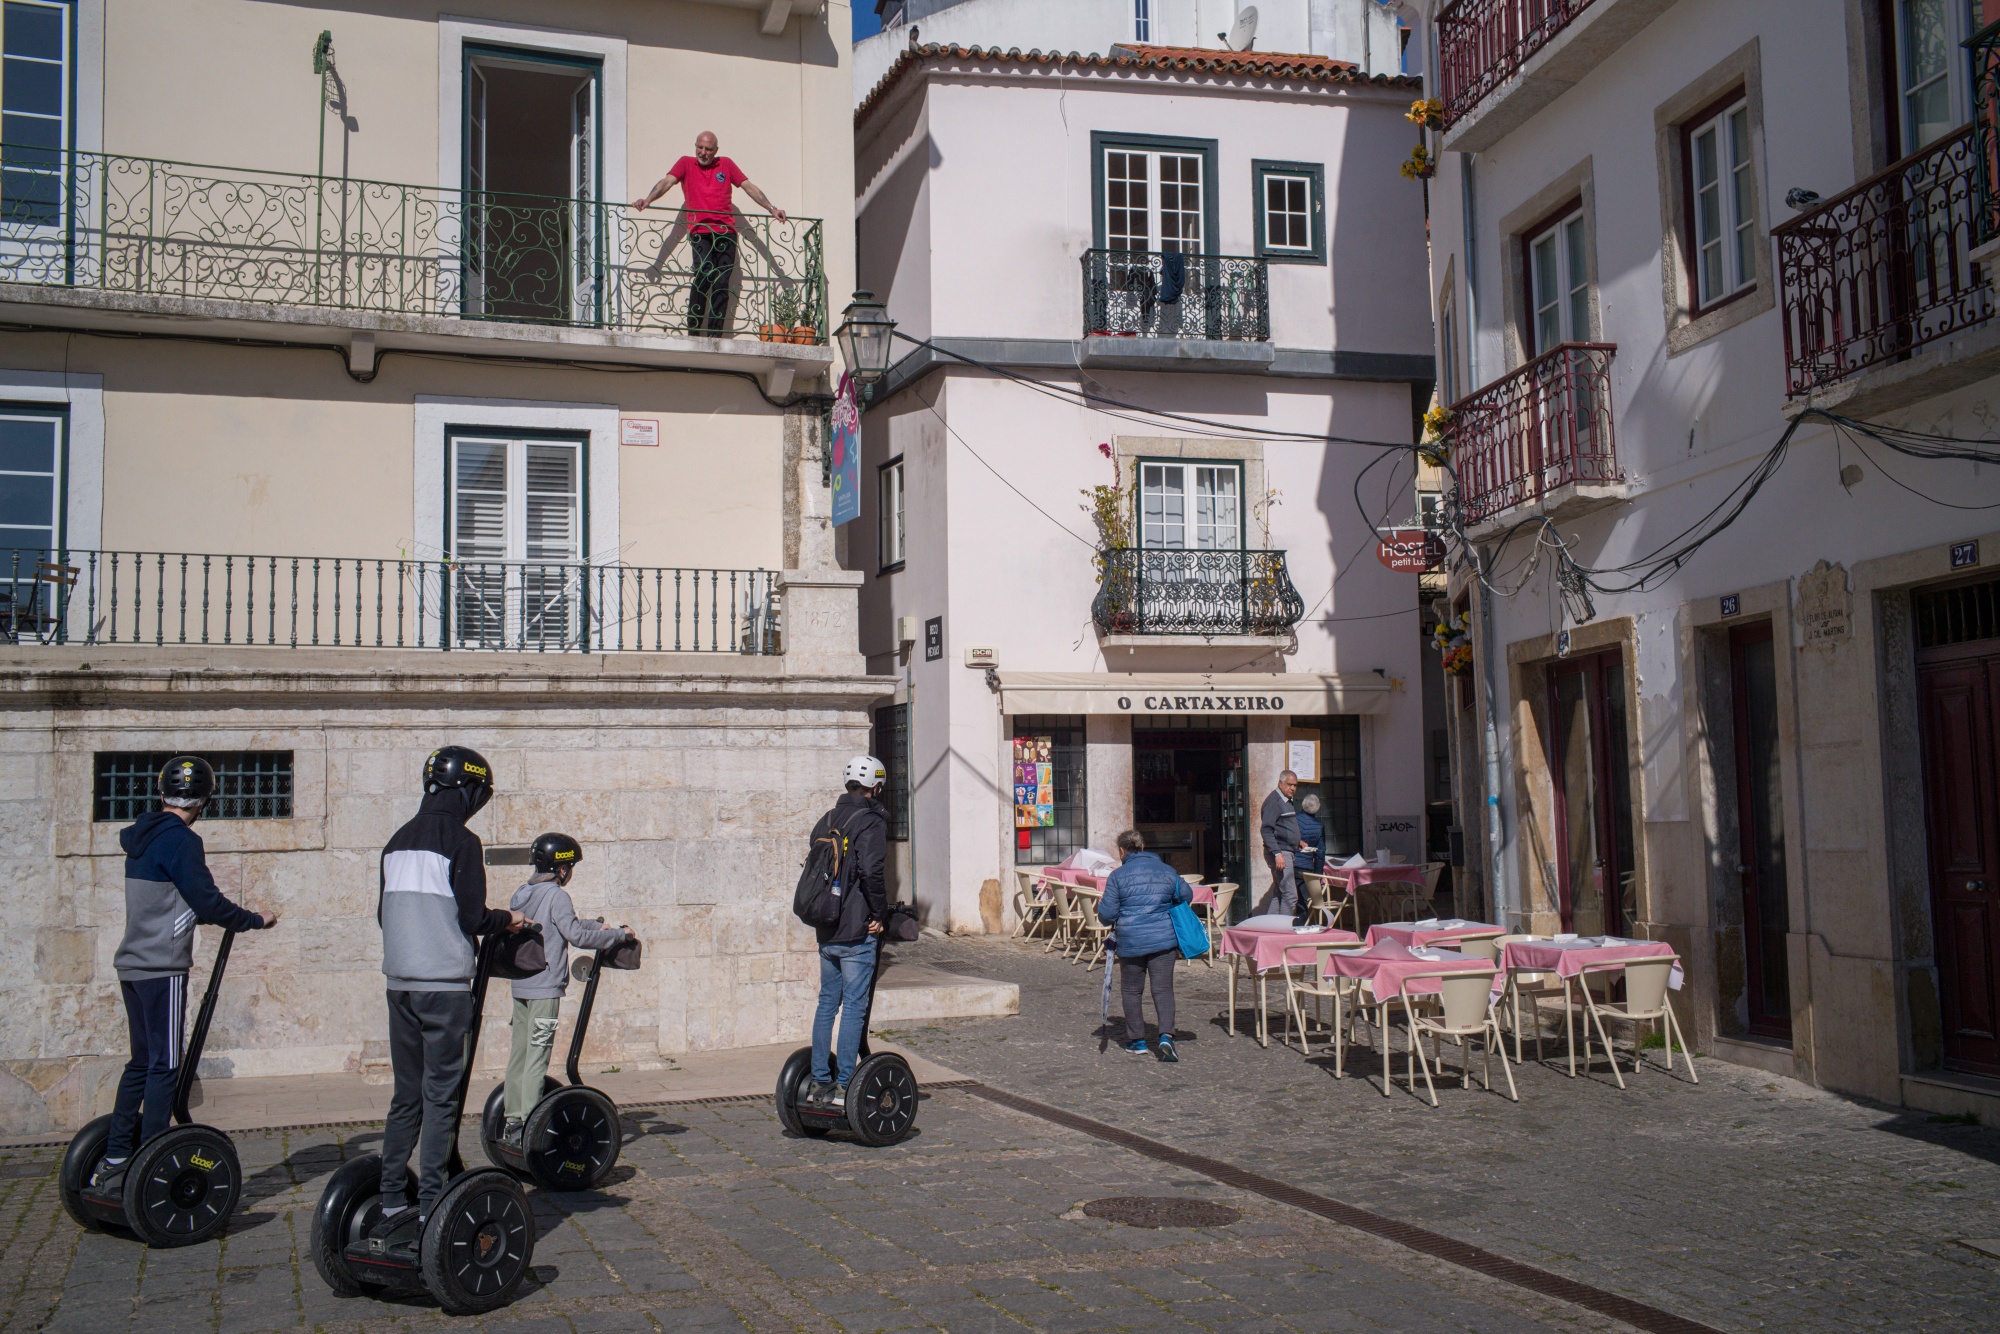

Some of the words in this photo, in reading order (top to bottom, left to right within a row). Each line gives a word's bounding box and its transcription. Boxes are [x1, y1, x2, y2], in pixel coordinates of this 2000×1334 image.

[1381, 541, 1441, 557] HOSTEL
[1955, 545, 1972, 565] 27
[1391, 558, 1411, 568] petit
[1723, 597, 1735, 614] 26
[805, 611, 841, 628] 1872
[1117, 696, 1132, 710] O
[1144, 696, 1284, 710] CARTAXEIRO
[464, 762, 487, 776] boost
[555, 850, 575, 859] boost
[190, 1154, 215, 1169] boost
[565, 1160, 586, 1171] boost
